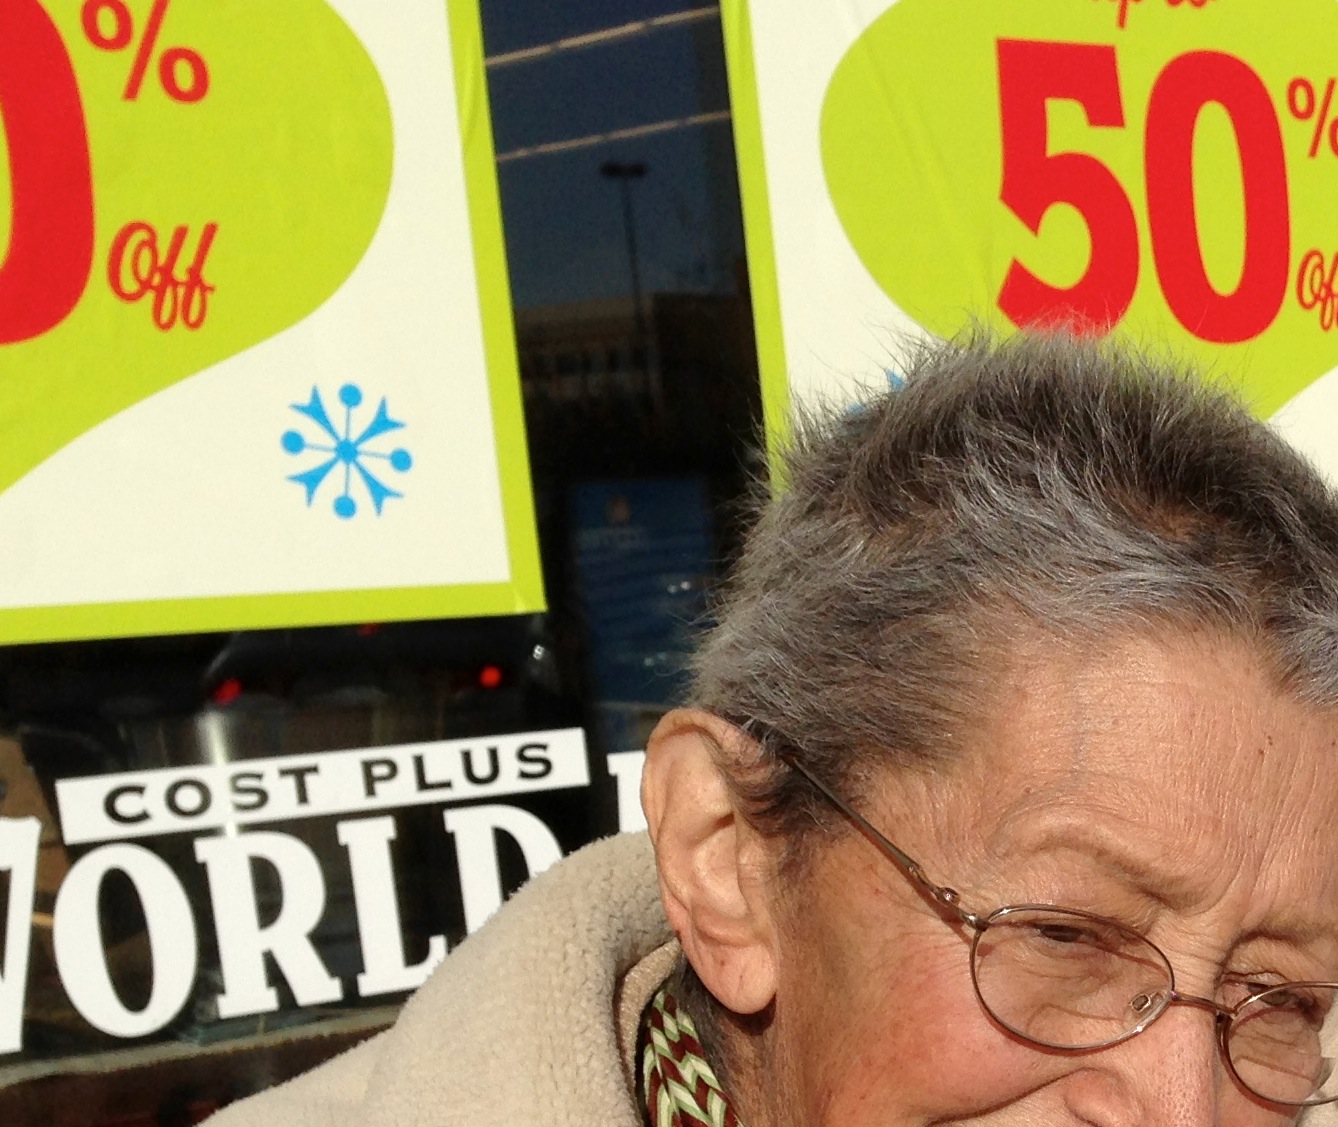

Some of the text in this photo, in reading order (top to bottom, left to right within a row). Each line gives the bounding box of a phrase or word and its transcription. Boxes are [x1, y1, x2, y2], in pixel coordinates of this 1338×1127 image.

[107, 220, 219, 332] Off
[102, 764, 320, 826] COST
[360, 742, 554, 798] PLUS
[0, 803, 564, 1055] ORLD
